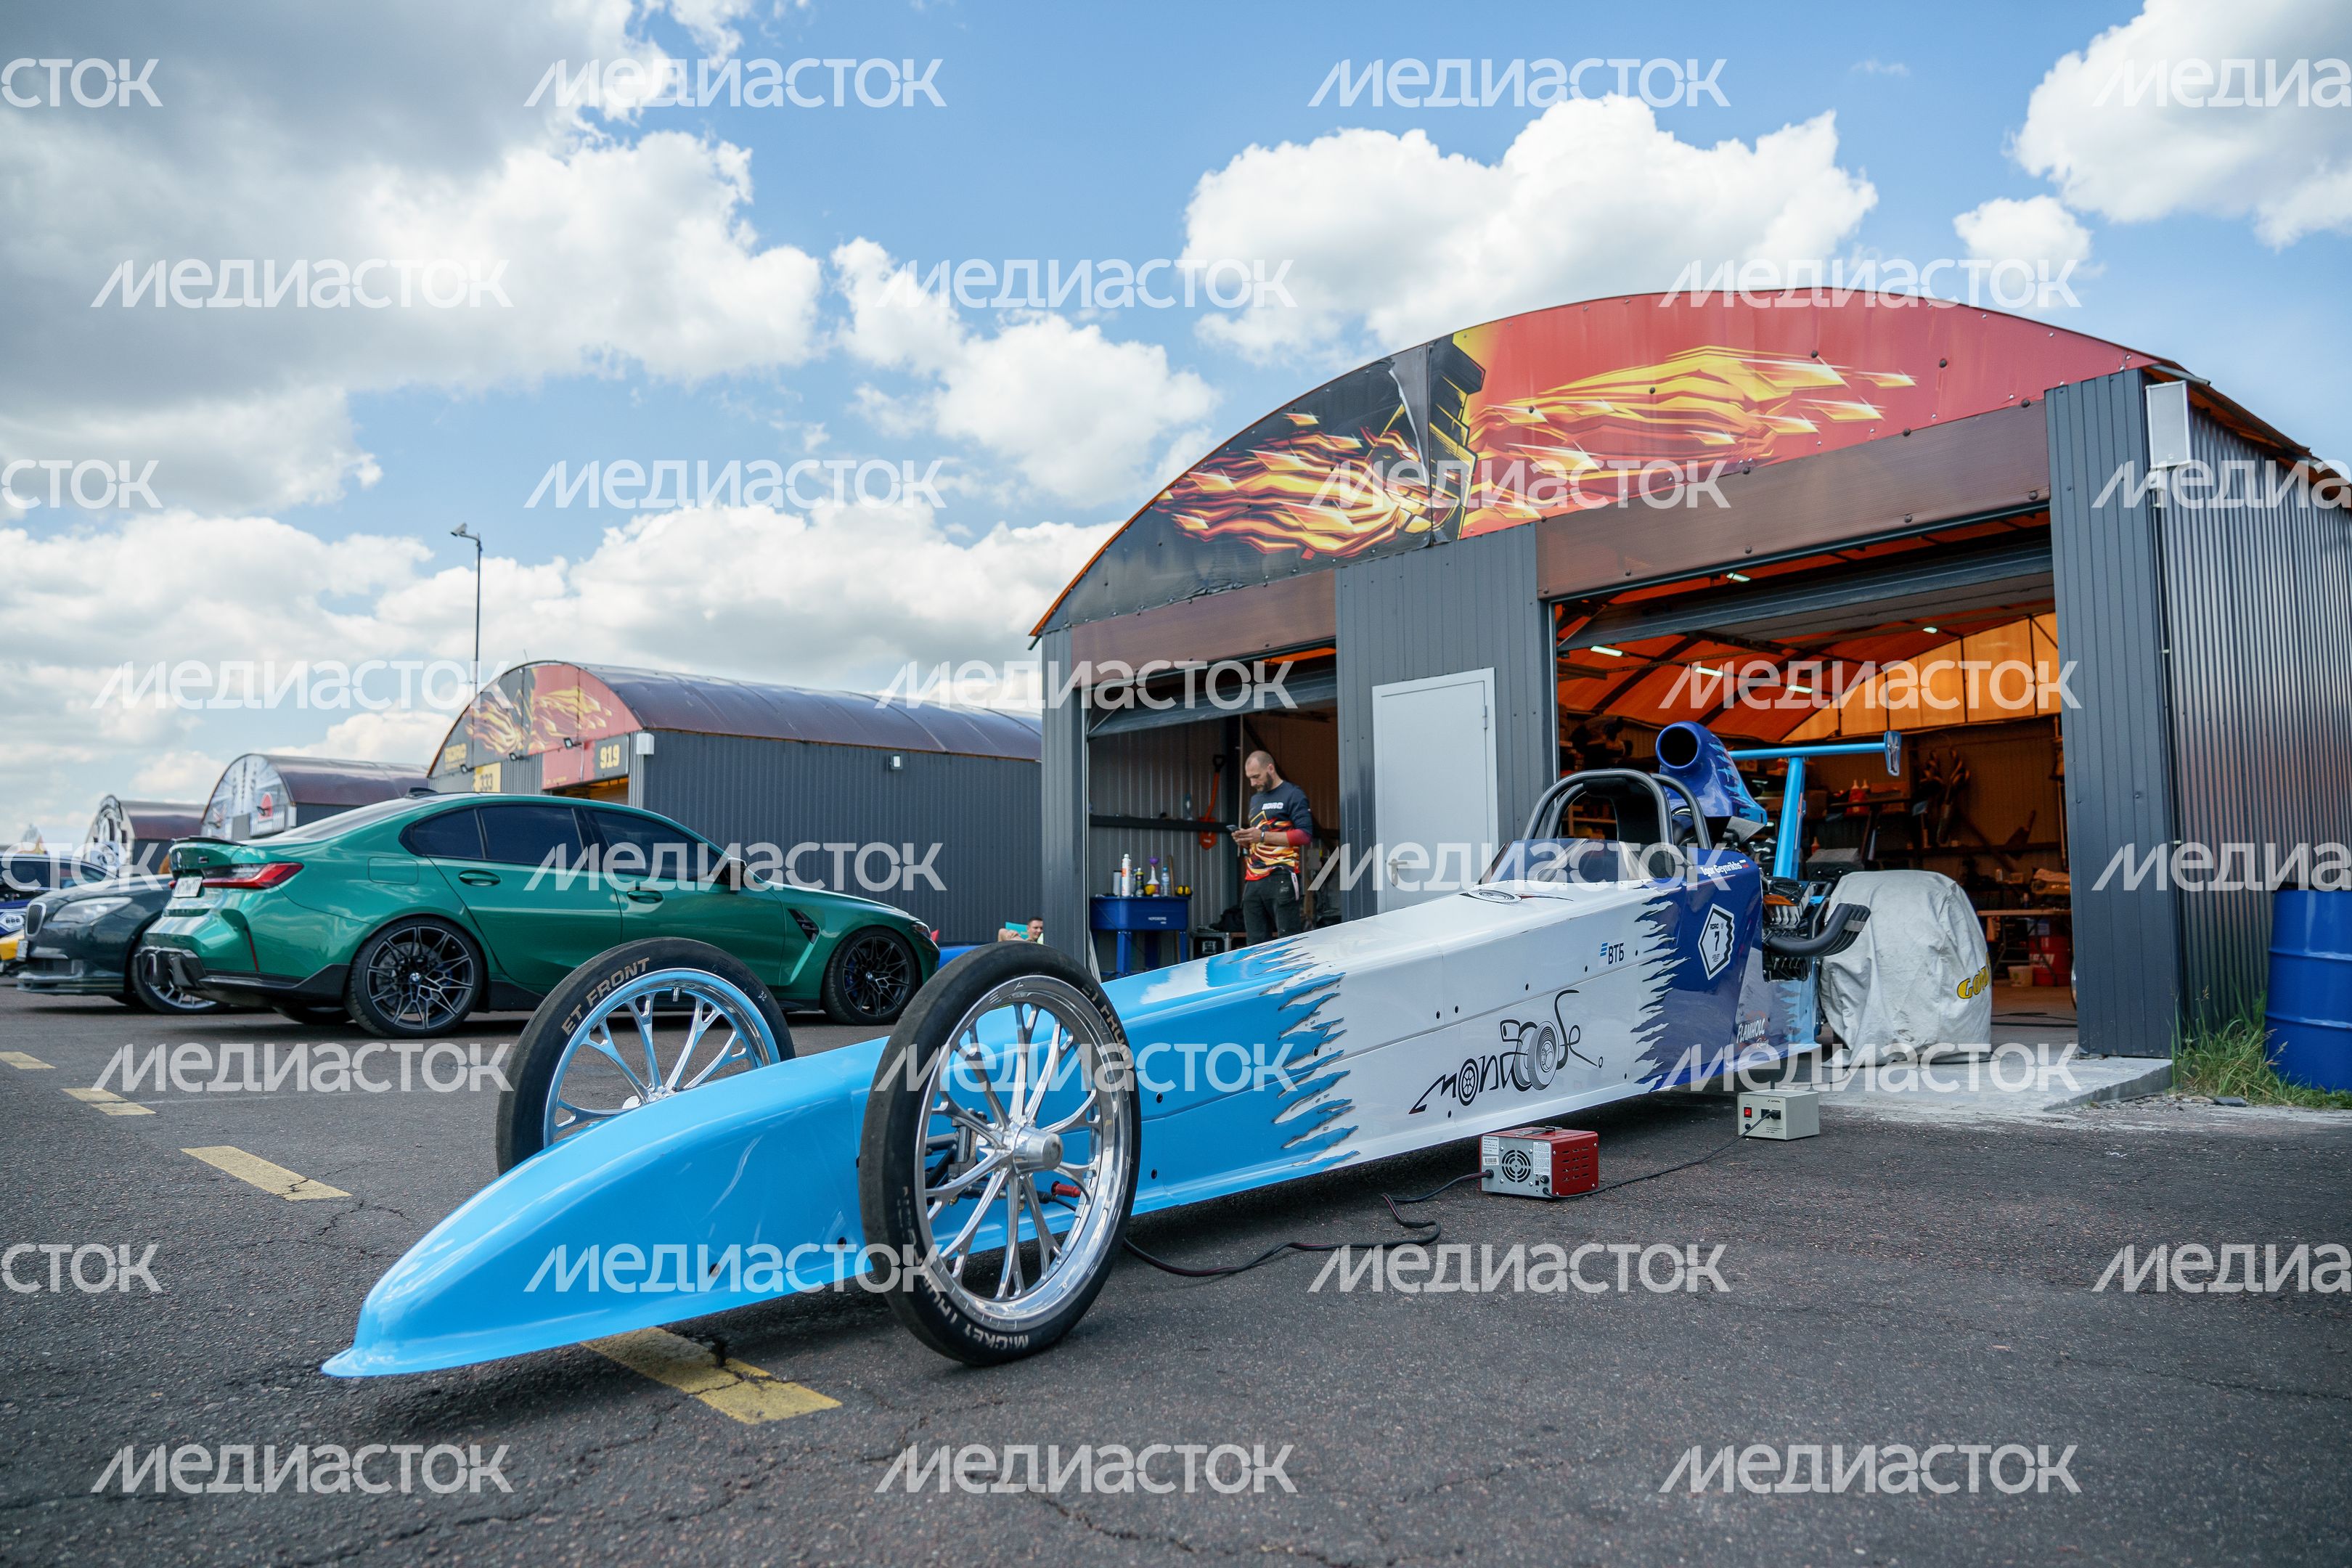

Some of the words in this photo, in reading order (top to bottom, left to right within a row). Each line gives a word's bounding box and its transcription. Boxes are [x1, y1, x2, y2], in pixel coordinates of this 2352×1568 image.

[599, 743, 620, 769] 919
[1714, 931, 1720, 951] 7
[1608, 942, 1625, 965] ВТБ
[561, 1004, 582, 1036] ET
[586, 957, 650, 1008] FRONT
